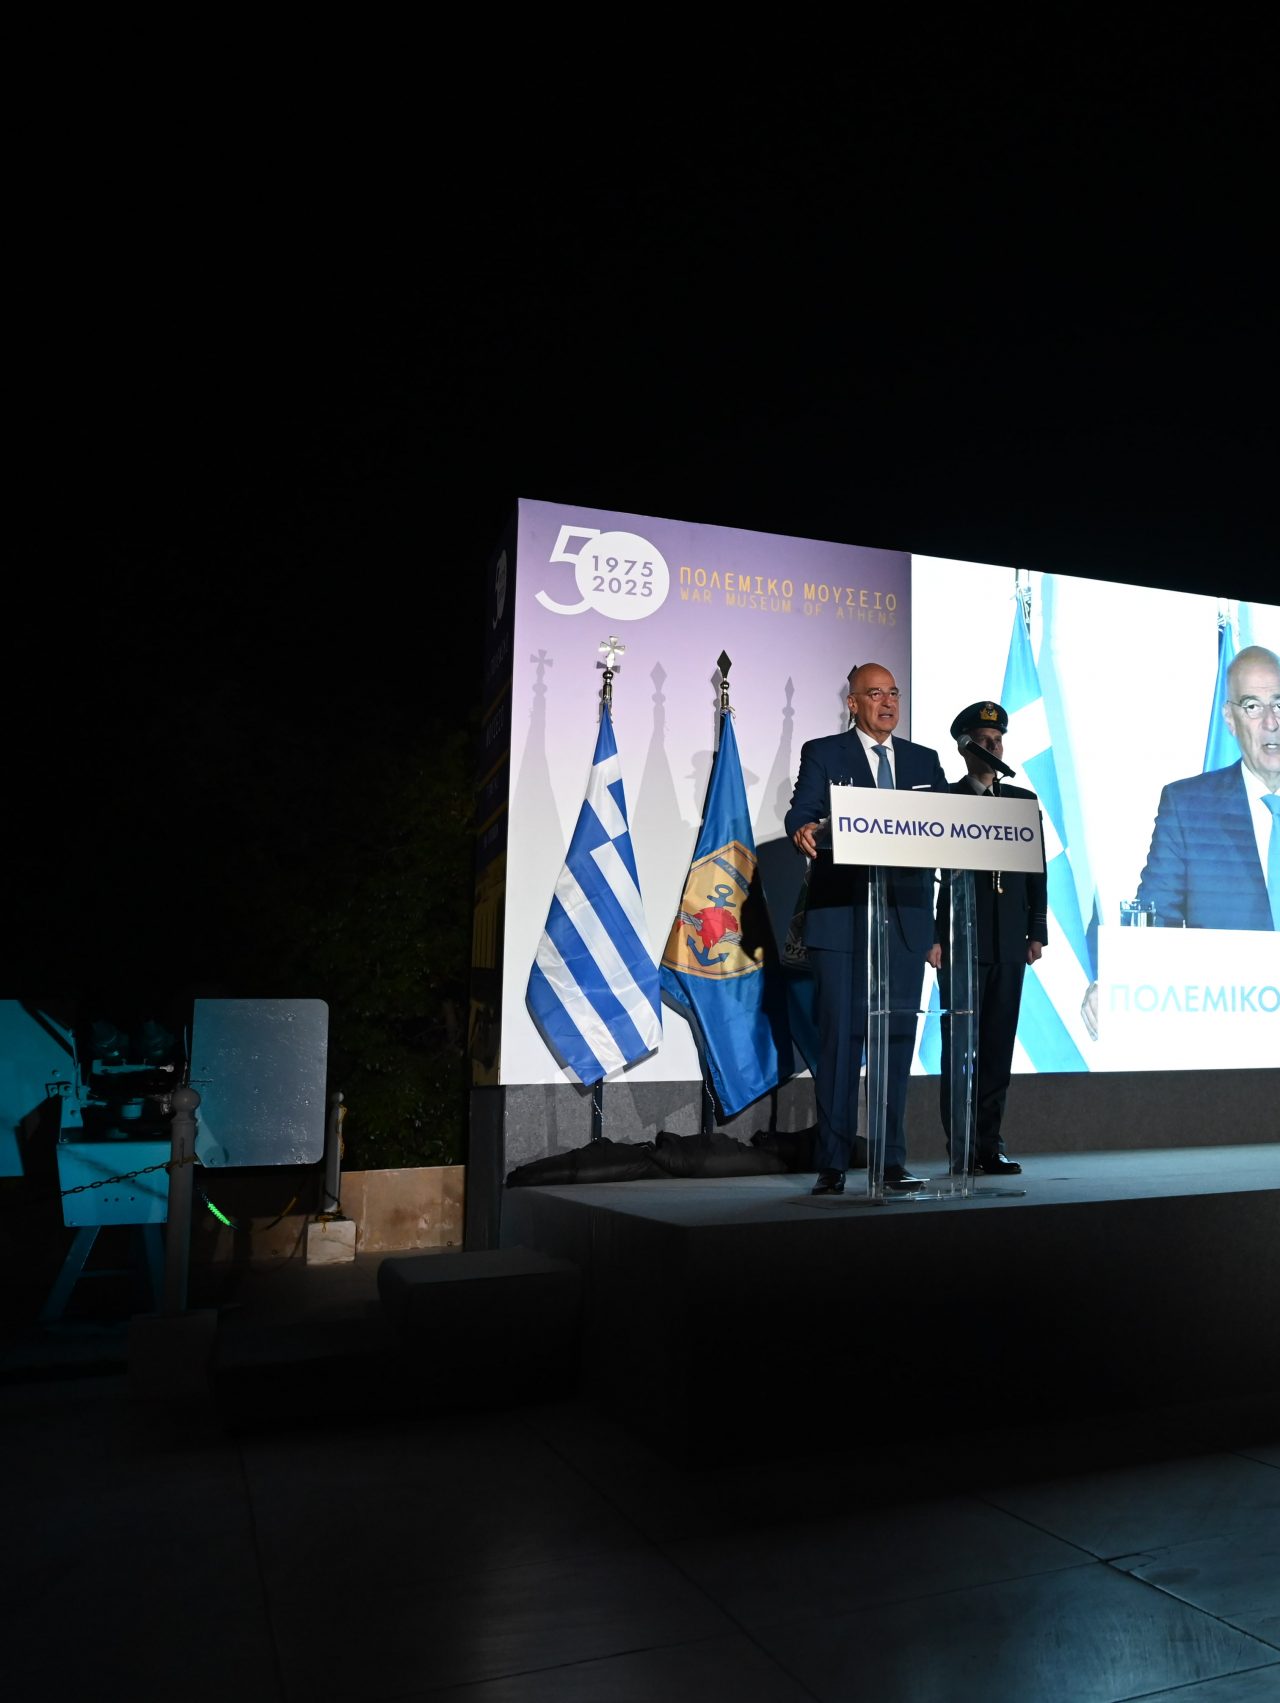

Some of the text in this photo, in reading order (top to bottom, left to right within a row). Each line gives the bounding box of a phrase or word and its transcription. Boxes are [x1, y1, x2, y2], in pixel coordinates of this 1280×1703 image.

[592, 555, 653, 577] 1975
[592, 576, 653, 597] 2025
[680, 566, 897, 611] ΠΟΛΕΜΙΚΟ ΜΟΥΣΕΙΟ
[680, 587, 897, 626] WAR MUSEUM OF ATHENS
[838, 817, 1034, 842] ΠΟΛΕΜΙΚΟ ΜΟΥΣΕΙΟ
